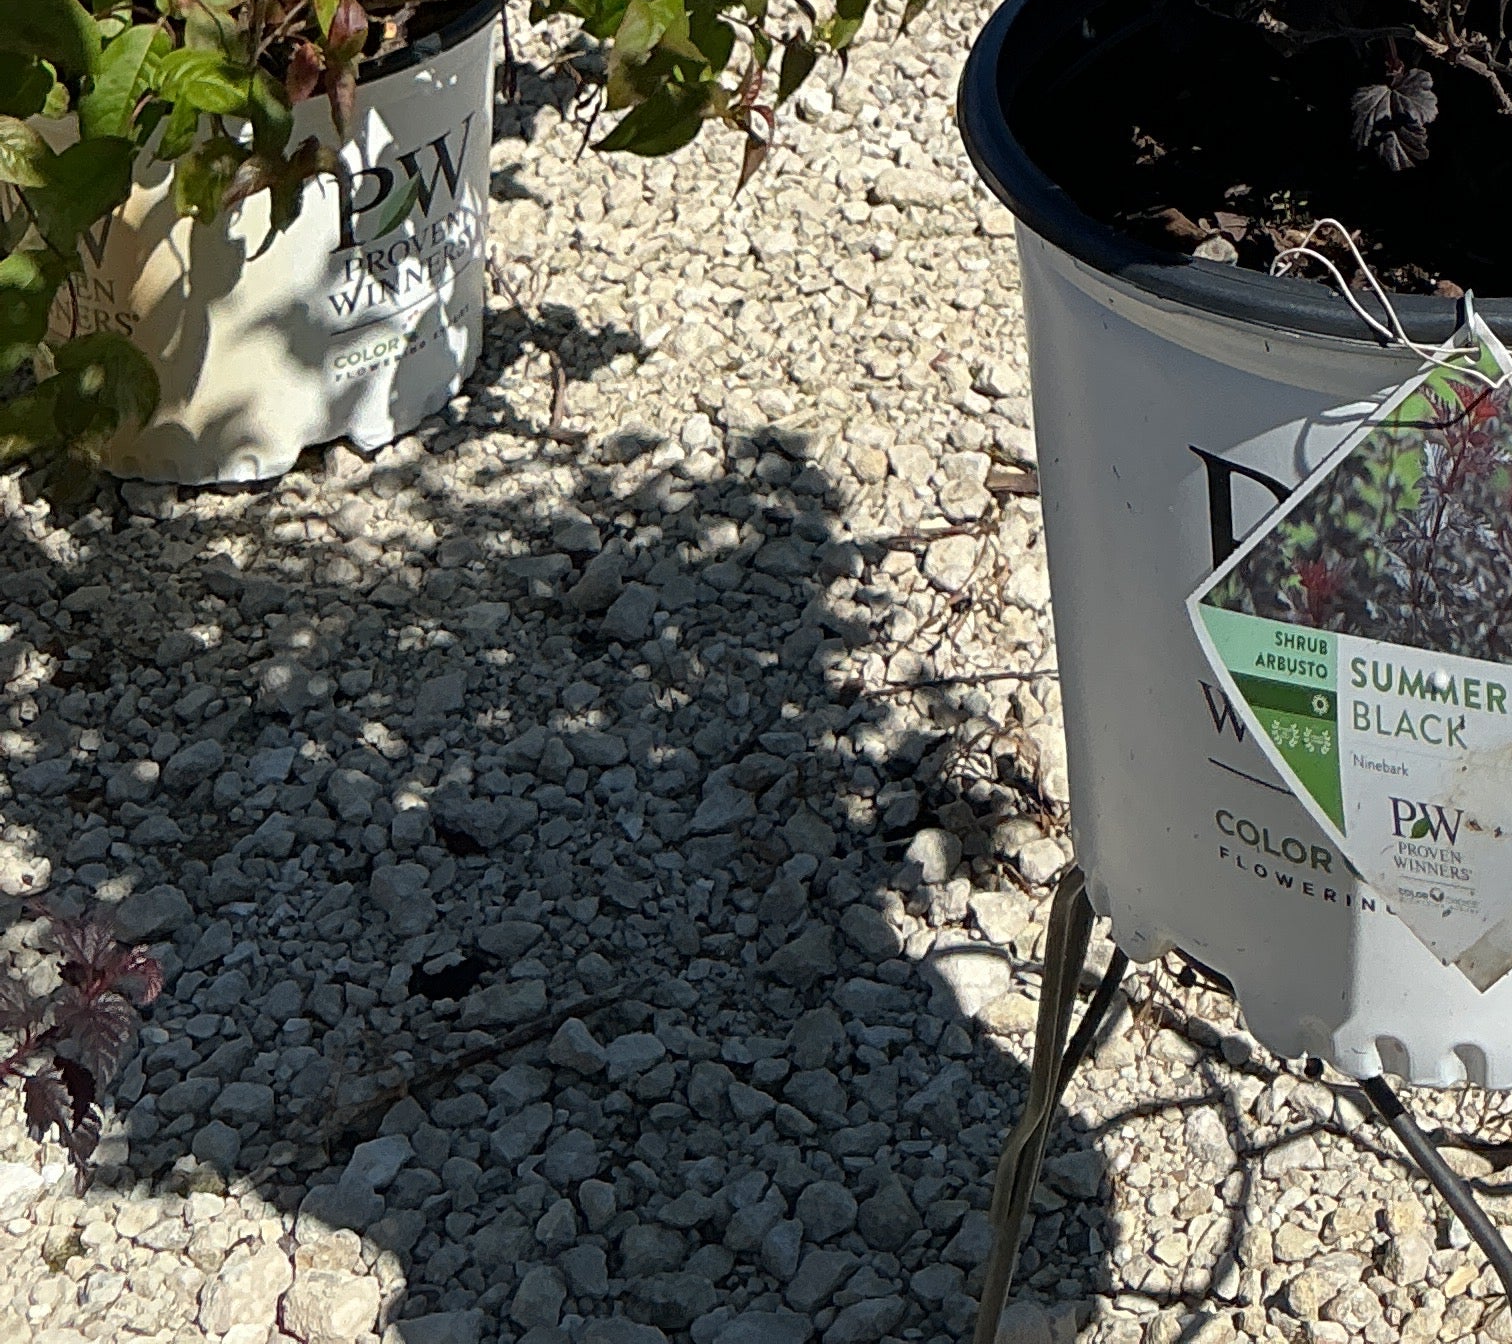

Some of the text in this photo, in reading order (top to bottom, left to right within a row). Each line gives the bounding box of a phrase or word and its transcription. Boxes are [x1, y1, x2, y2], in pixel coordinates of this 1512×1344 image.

[330, 111, 475, 254] PW
[1254, 651, 1329, 680] ARBUSTO
[1274, 630, 1329, 656] SHRUB
[1351, 656, 1508, 714] SUMMER
[1353, 699, 1468, 750] BLACK
[1353, 753, 1409, 777] Ninebark
[1216, 809, 1333, 874] COLOR
[1388, 796, 1465, 846] PW
[1399, 840, 1463, 864] PROVEN
